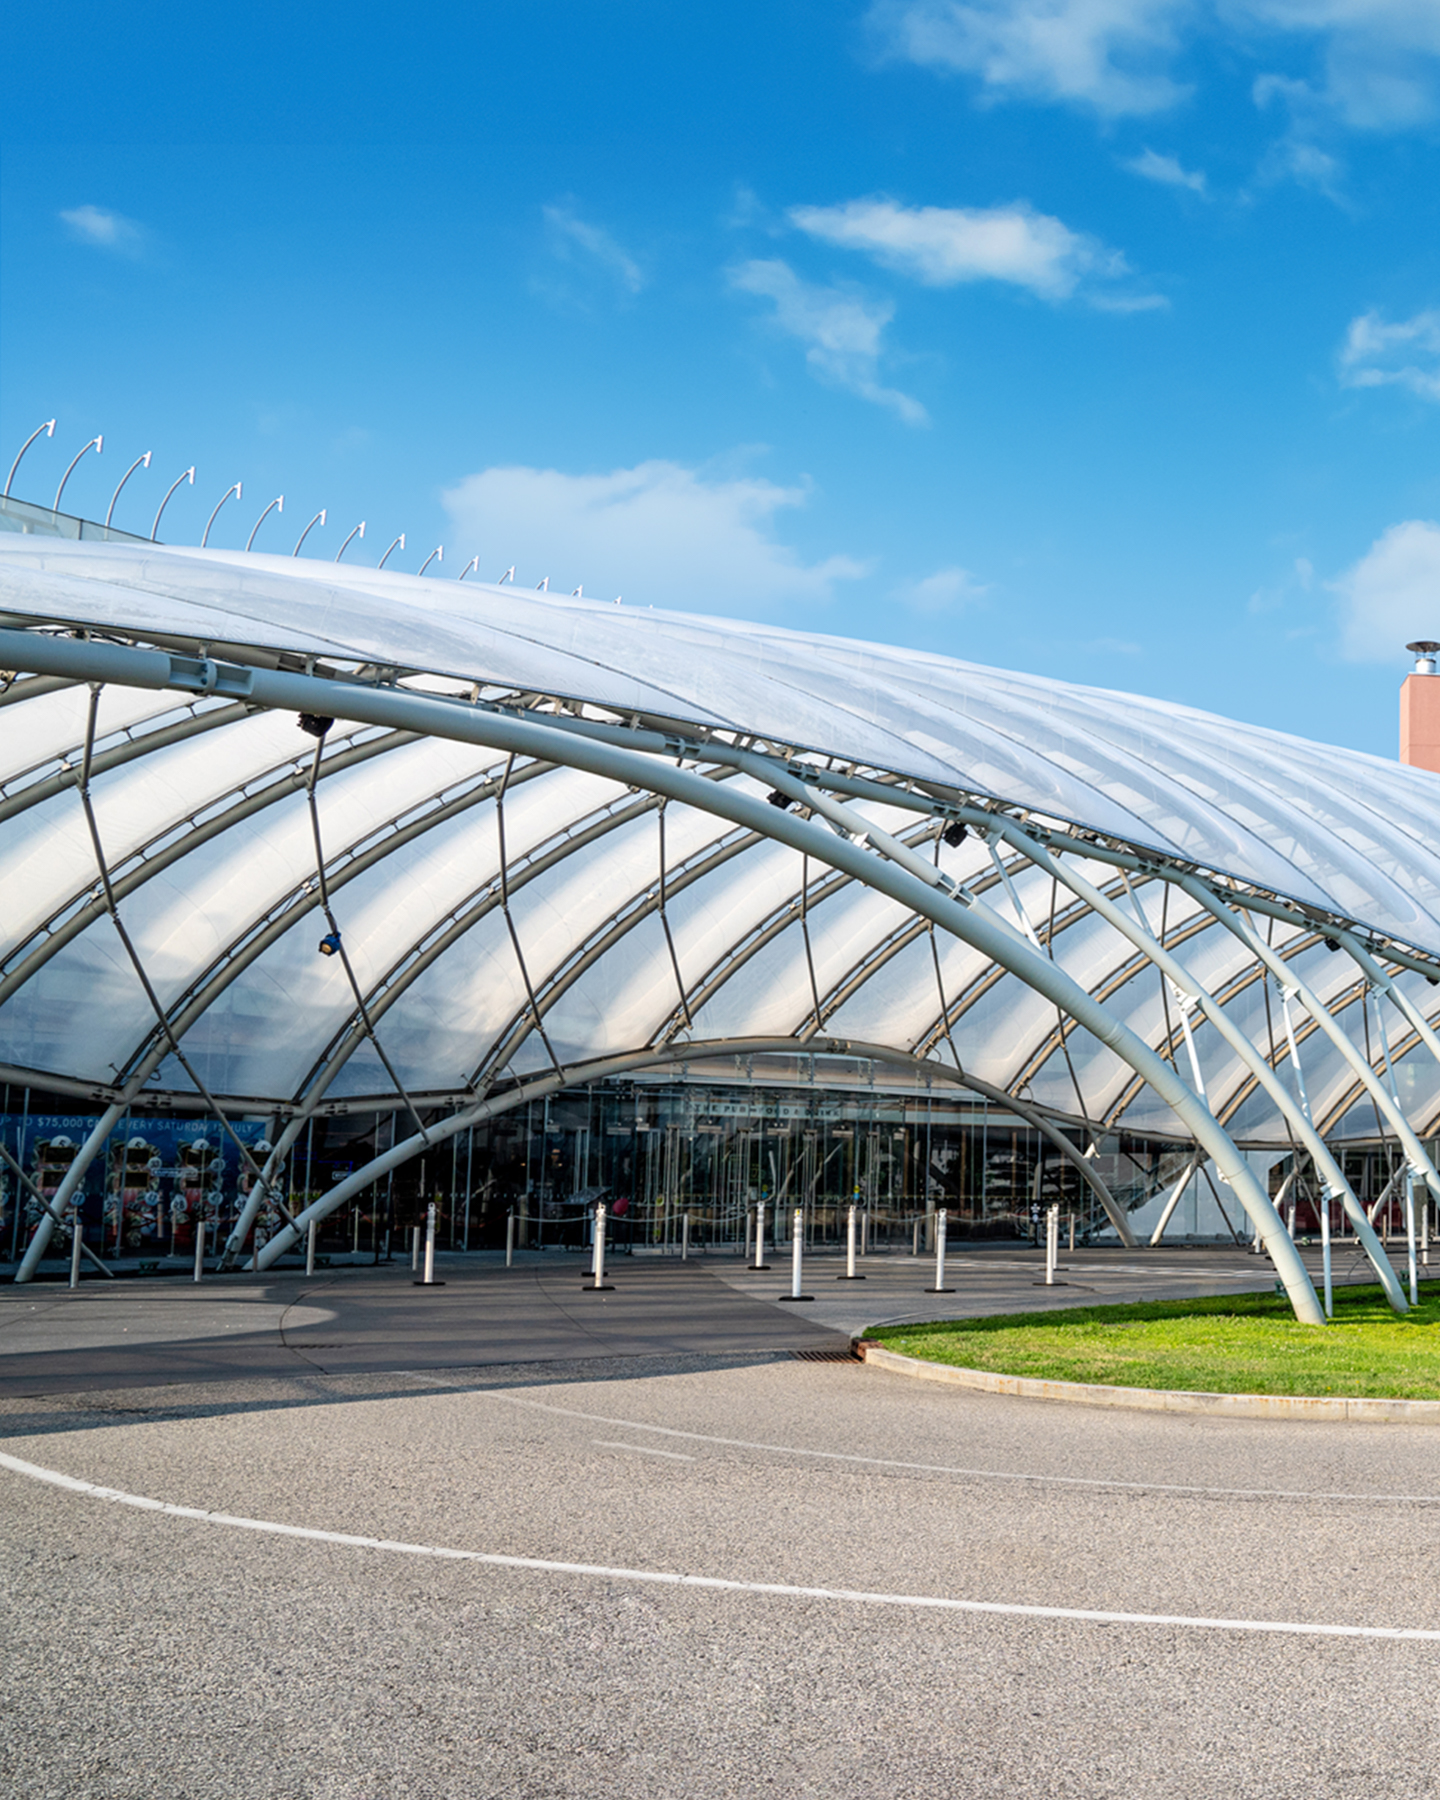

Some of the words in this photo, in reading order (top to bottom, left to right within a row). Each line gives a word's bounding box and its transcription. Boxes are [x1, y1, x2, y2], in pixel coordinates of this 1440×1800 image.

[37, 1116, 83, 1129] $75,000
[117, 1119, 153, 1130] EVERY
[156, 1120, 210, 1132] SATURDAY
